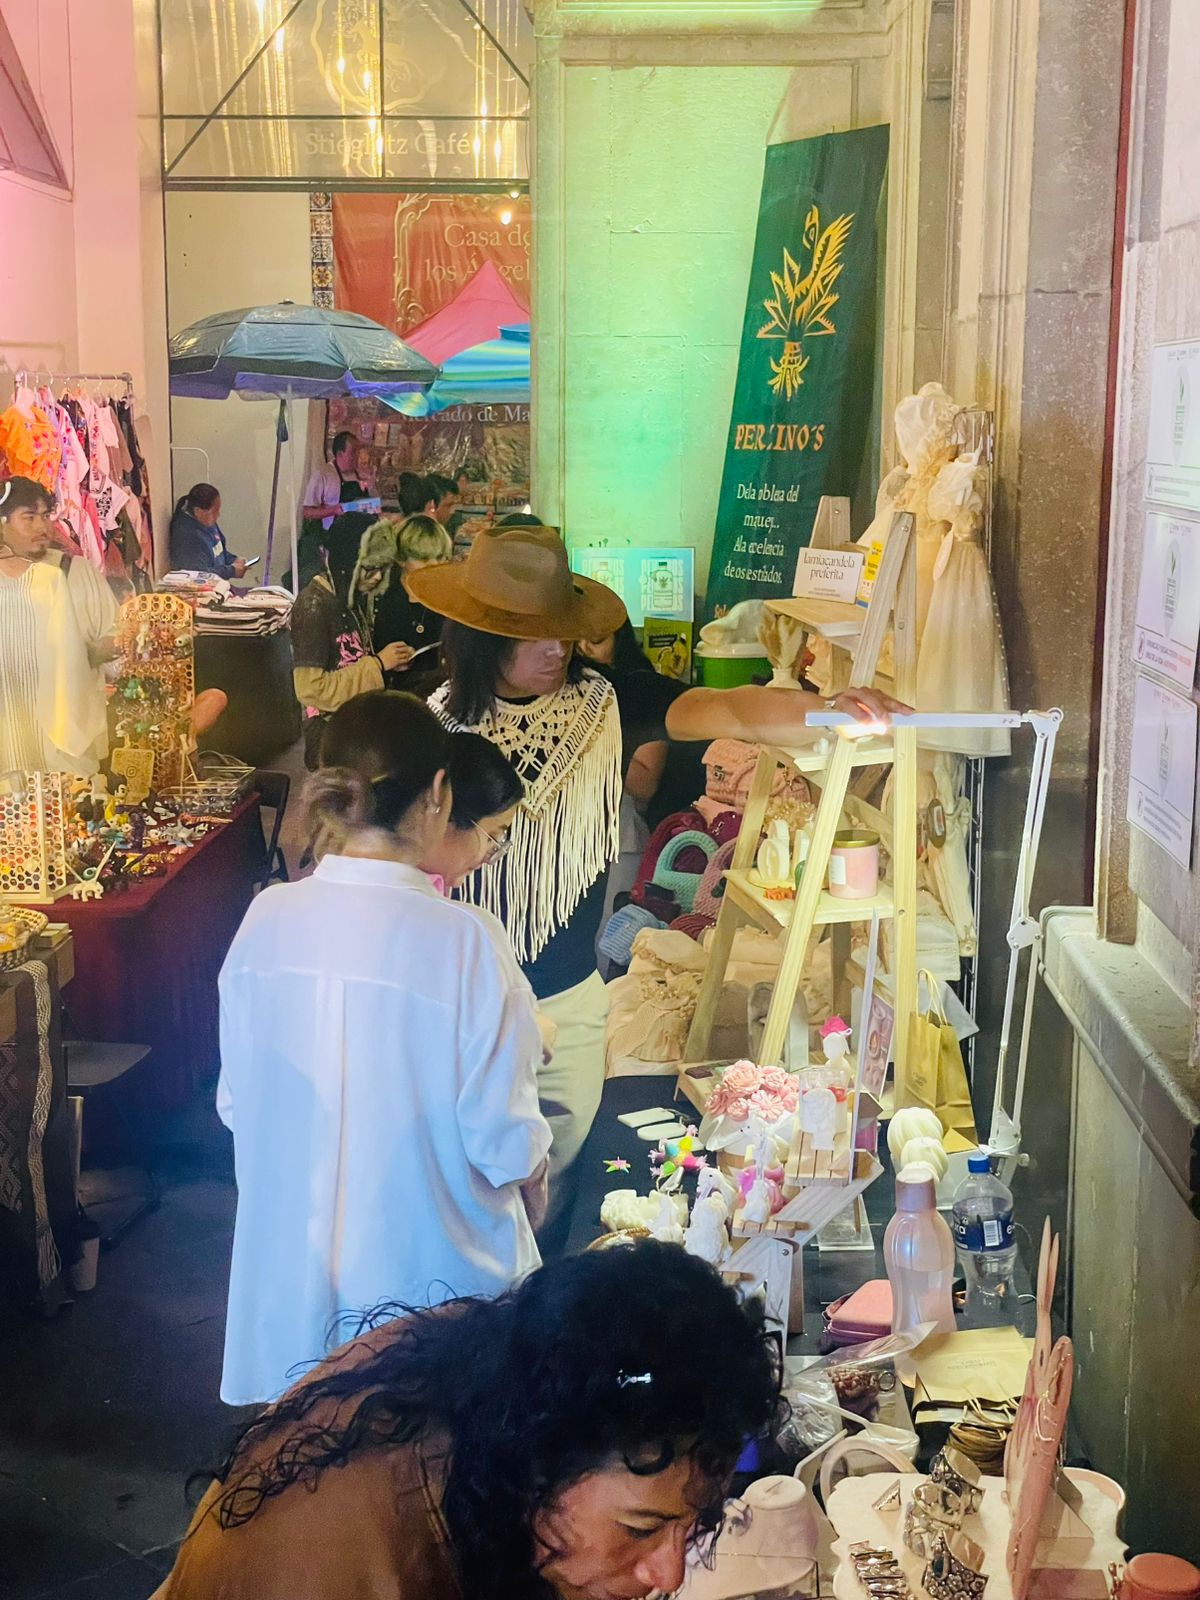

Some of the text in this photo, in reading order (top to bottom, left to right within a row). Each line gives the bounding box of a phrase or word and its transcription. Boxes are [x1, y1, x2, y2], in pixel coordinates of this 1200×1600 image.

[304, 132, 471, 160] Stiegltz Café
[444, 223, 502, 247] Casa
[424, 258, 457, 282] los
[477, 402, 498, 422] de
